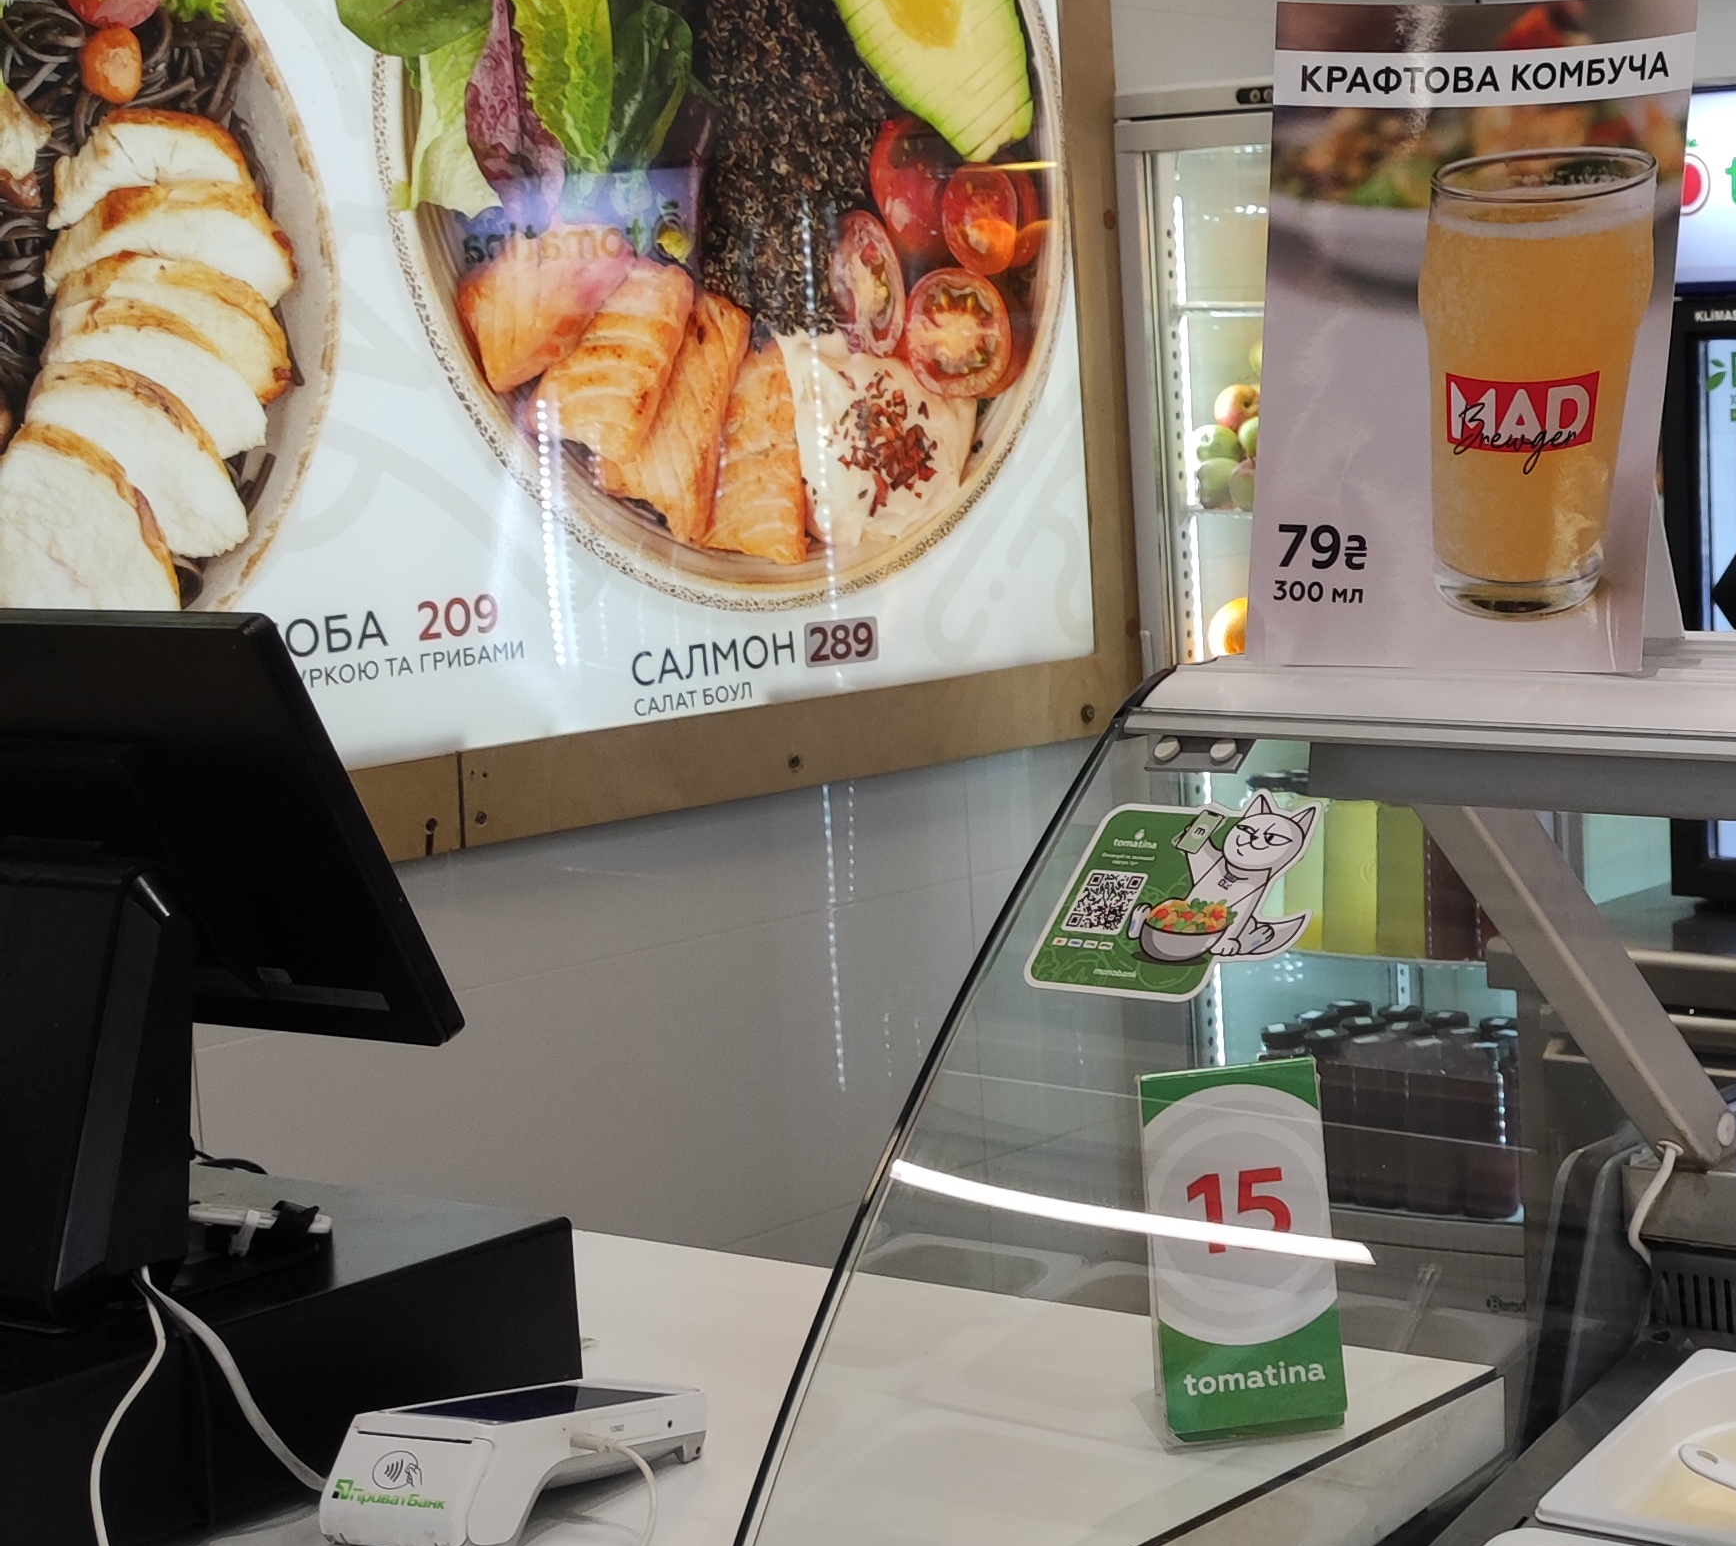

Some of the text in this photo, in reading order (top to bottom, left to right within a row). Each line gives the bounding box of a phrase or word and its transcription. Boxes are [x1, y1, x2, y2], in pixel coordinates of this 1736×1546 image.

[1299, 51, 1670, 97] КРАФТОВА КОМБУЧА
[1450, 381, 1590, 445] MAD
[1273, 580, 1364, 604] 300 мл
[274, 593, 499, 658] ОБА 209
[385, 640, 525, 678] ТА ГРИБАМИ
[631, 621, 874, 687] САЛМОН 289
[633, 681, 753, 717] САЛАТ БОУЛ
[1113, 837, 1158, 850] tomatina
[1186, 1166, 1292, 1254] 15
[1182, 1360, 1326, 1397] tomatina
